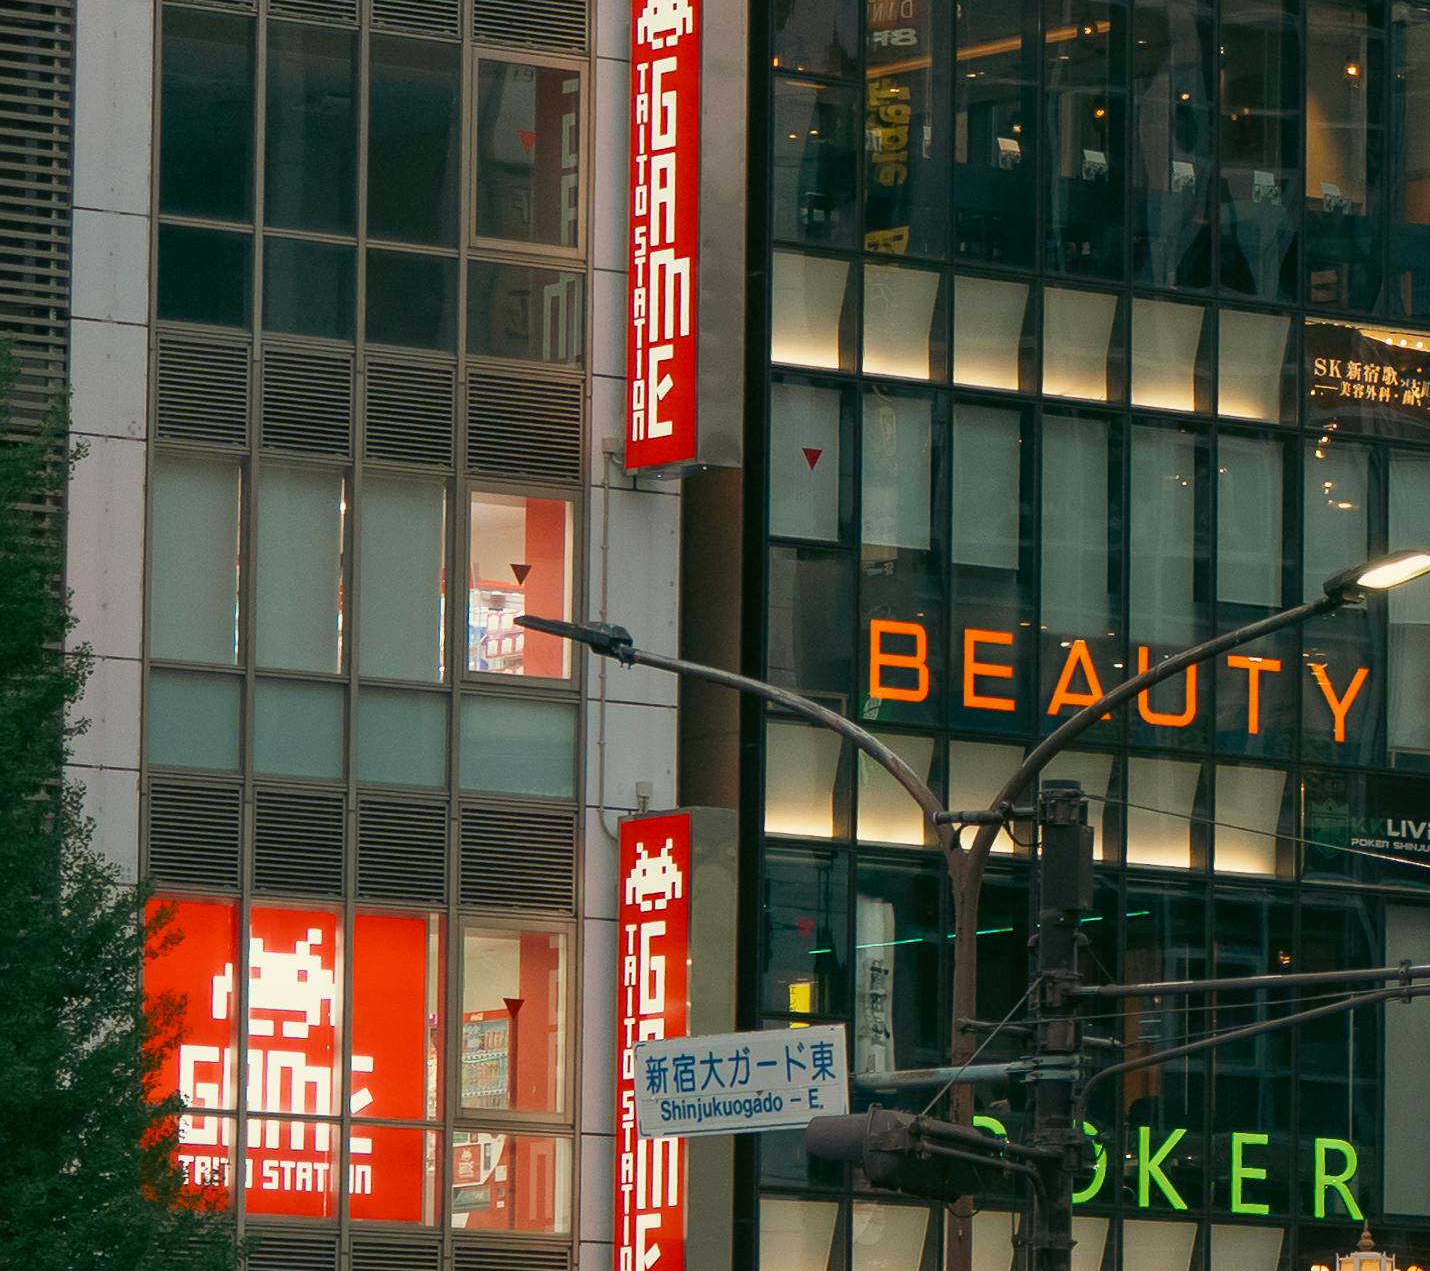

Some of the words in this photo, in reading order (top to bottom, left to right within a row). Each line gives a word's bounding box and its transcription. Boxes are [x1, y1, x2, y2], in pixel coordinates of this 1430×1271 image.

[635, 62, 650, 216] TAITO
[647, 57, 690, 439] GAME
[632, 230, 648, 442] STATION
[869, 619, 1369, 743] BEAUTY
[623, 924, 637, 1077] TAITO
[644, 1041, 838, 1095] 新宿大ガード東
[179, 1044, 374, 1155] GAME
[659, 1098, 783, 1122] Shinjukuogado
[808, 1094, 825, 1111] E.
